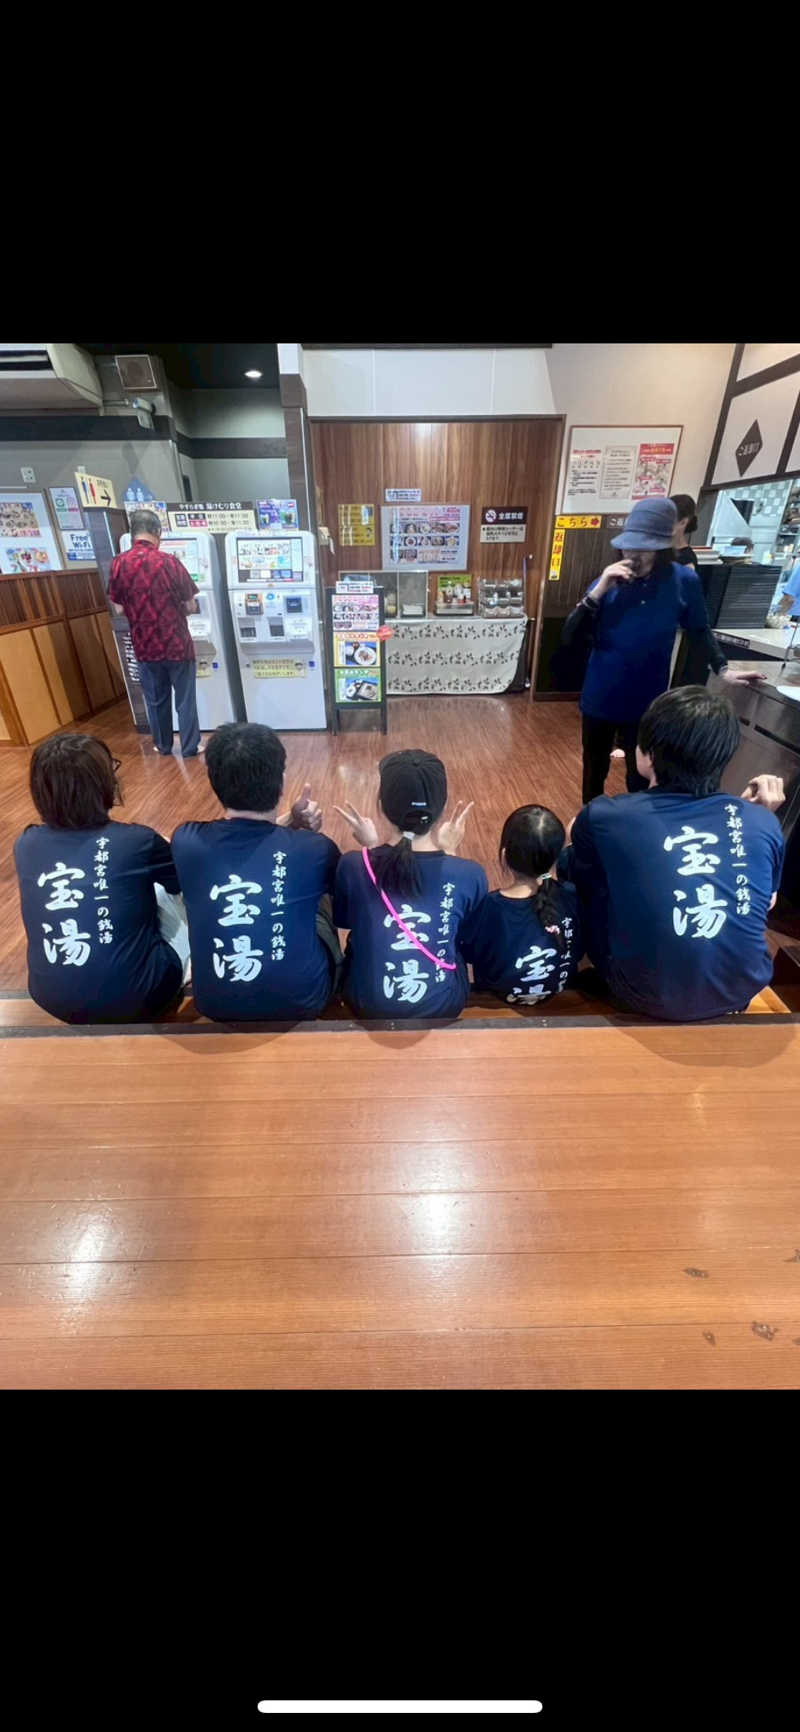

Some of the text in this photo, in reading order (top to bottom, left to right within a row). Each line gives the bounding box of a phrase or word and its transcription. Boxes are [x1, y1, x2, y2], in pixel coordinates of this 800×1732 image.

[70, 533, 89, 543] Free
[557, 516, 588, 528] こちら
[37, 861, 94, 967] 宝湯
[93, 836, 114, 945] 宇都宮唯一の銭湯
[270, 850, 288, 961] 宇都宮唯一の銭湯
[664, 825, 728, 940] 宝湯
[724, 803, 752, 916] 宇都宮唯一の銭湯
[209, 873, 263, 983] 宝湯
[383, 903, 432, 1004] 宝湯
